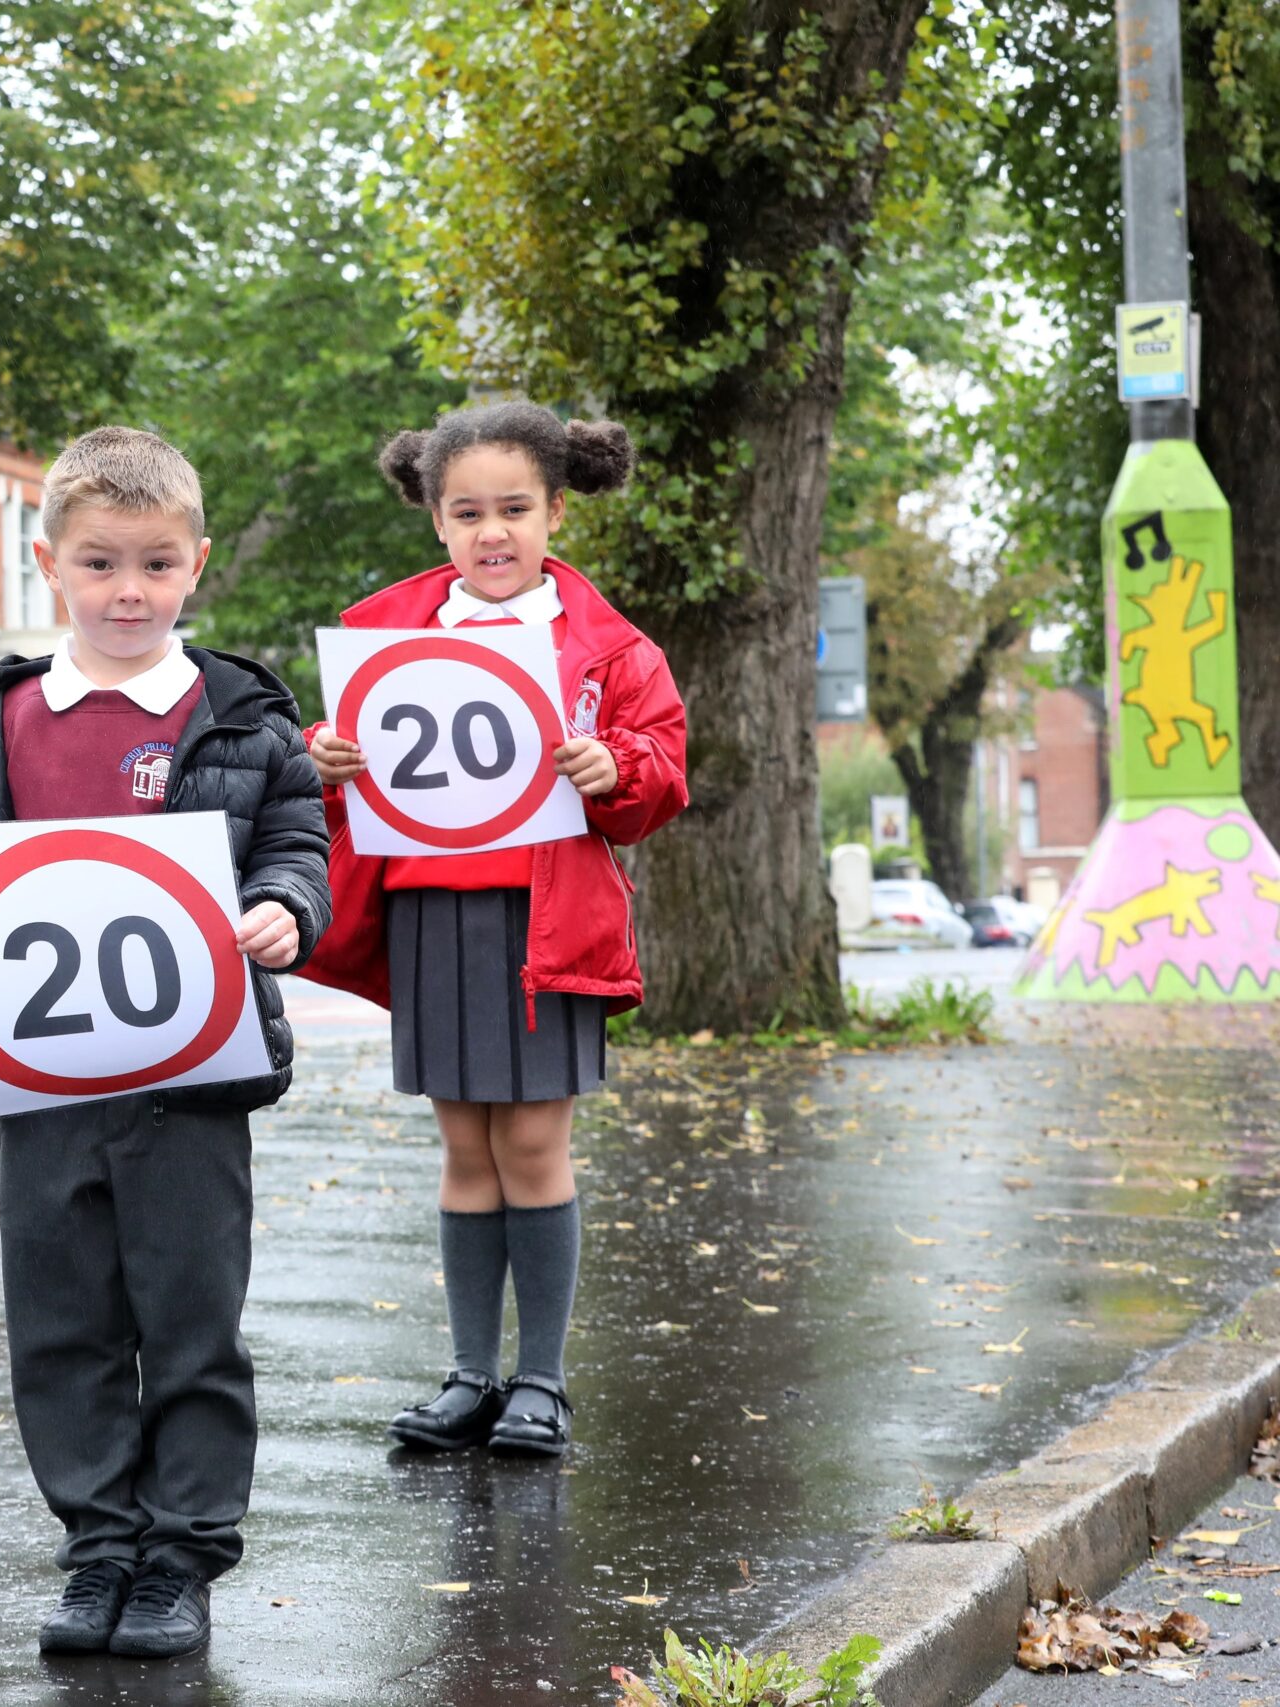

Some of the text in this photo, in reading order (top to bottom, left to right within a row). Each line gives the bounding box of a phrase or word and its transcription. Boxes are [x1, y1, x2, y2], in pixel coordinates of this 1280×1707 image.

[119, 742, 175, 774] CURRIE PRIMA
[380, 700, 516, 790] 20
[3, 914, 182, 1041] 20
